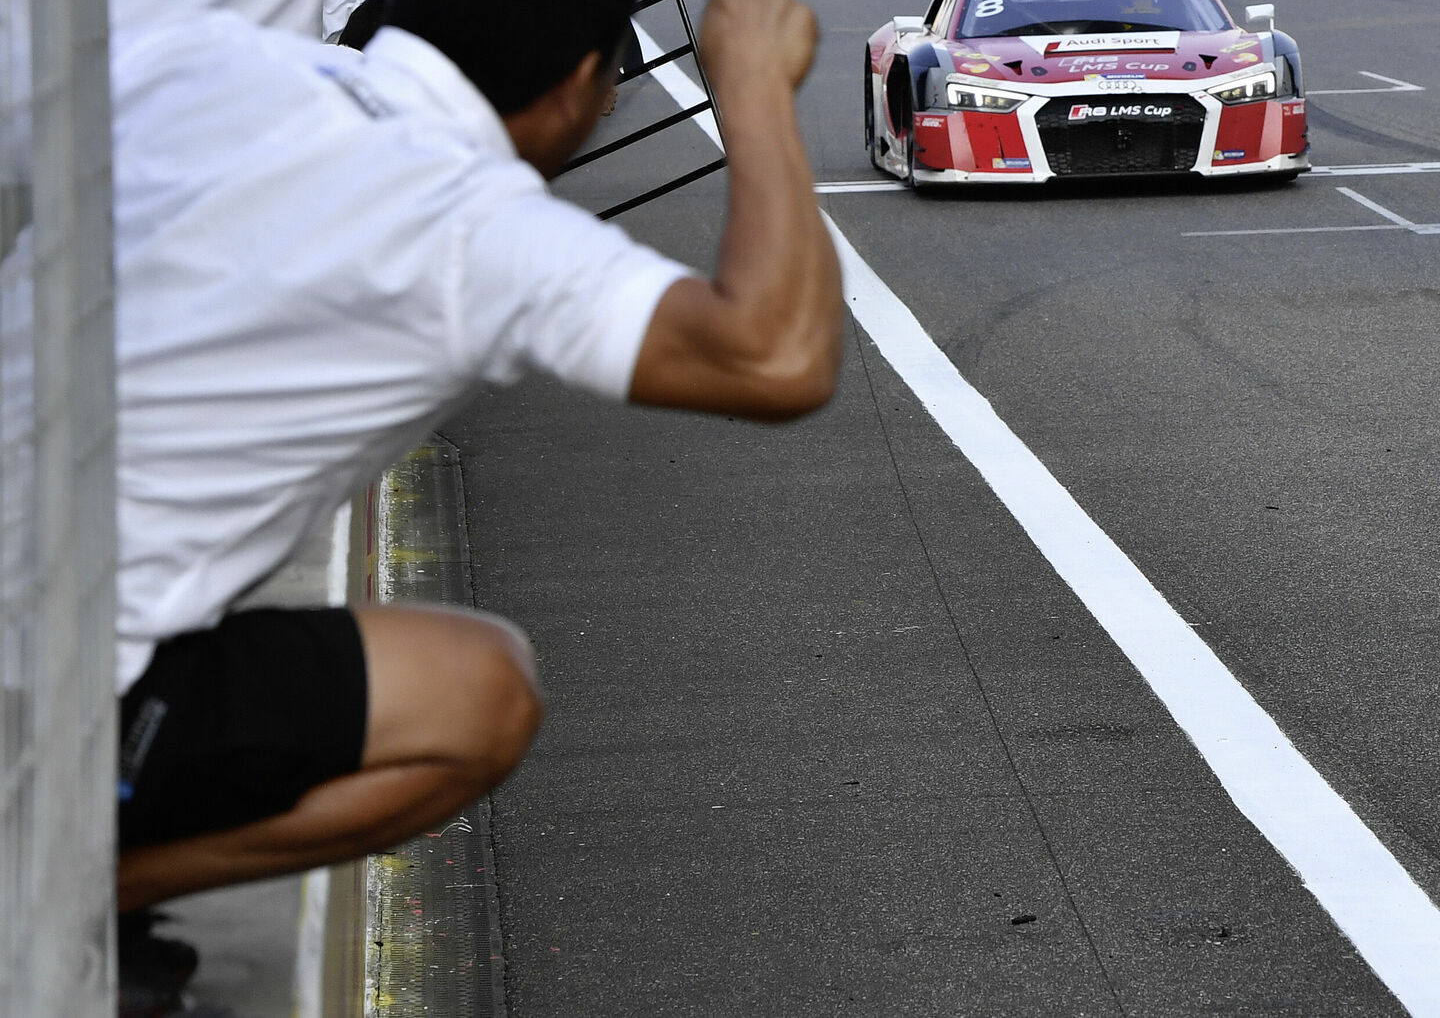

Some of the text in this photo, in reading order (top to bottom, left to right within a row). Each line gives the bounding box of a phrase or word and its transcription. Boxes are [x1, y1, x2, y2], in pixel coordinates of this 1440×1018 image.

[1066, 37, 1160, 47] Audi Sport
[1068, 61, 1170, 73] LMS Cup
[1110, 105, 1142, 116] LMS
[1144, 105, 1172, 118] Cup
